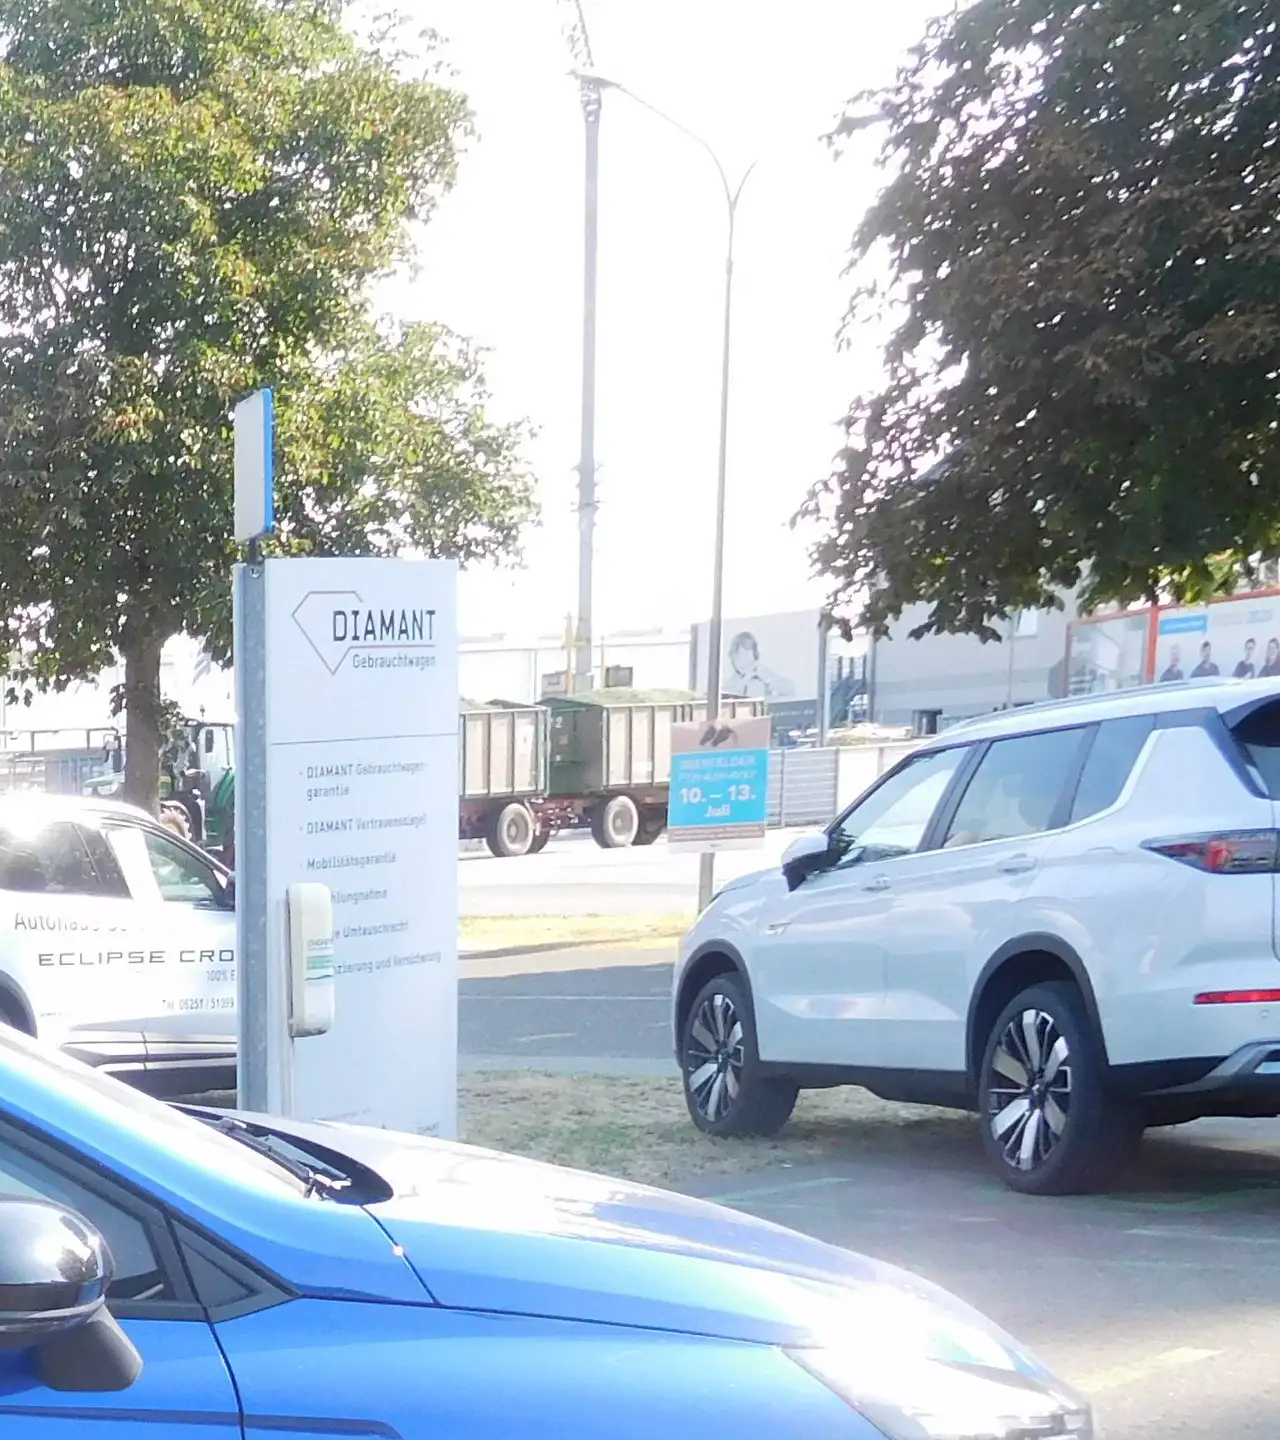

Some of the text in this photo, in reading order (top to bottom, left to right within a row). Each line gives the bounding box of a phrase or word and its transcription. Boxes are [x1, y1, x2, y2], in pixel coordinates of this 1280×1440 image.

[333, 609, 436, 641] DIAMANT
[352, 653, 436, 671] Gebrauchtwagen
[306, 764, 353, 779] DIAMANT
[306, 784, 349, 801] garantie
[680, 787, 707, 804] 10.
[728, 784, 757, 801] 13.
[306, 819, 353, 834] DIAMANT
[307, 853, 397, 870] Mobilitätsgarantie
[343, 920, 408, 938] Umtauschrecht
[38, 951, 165, 966] ECLIPSE
